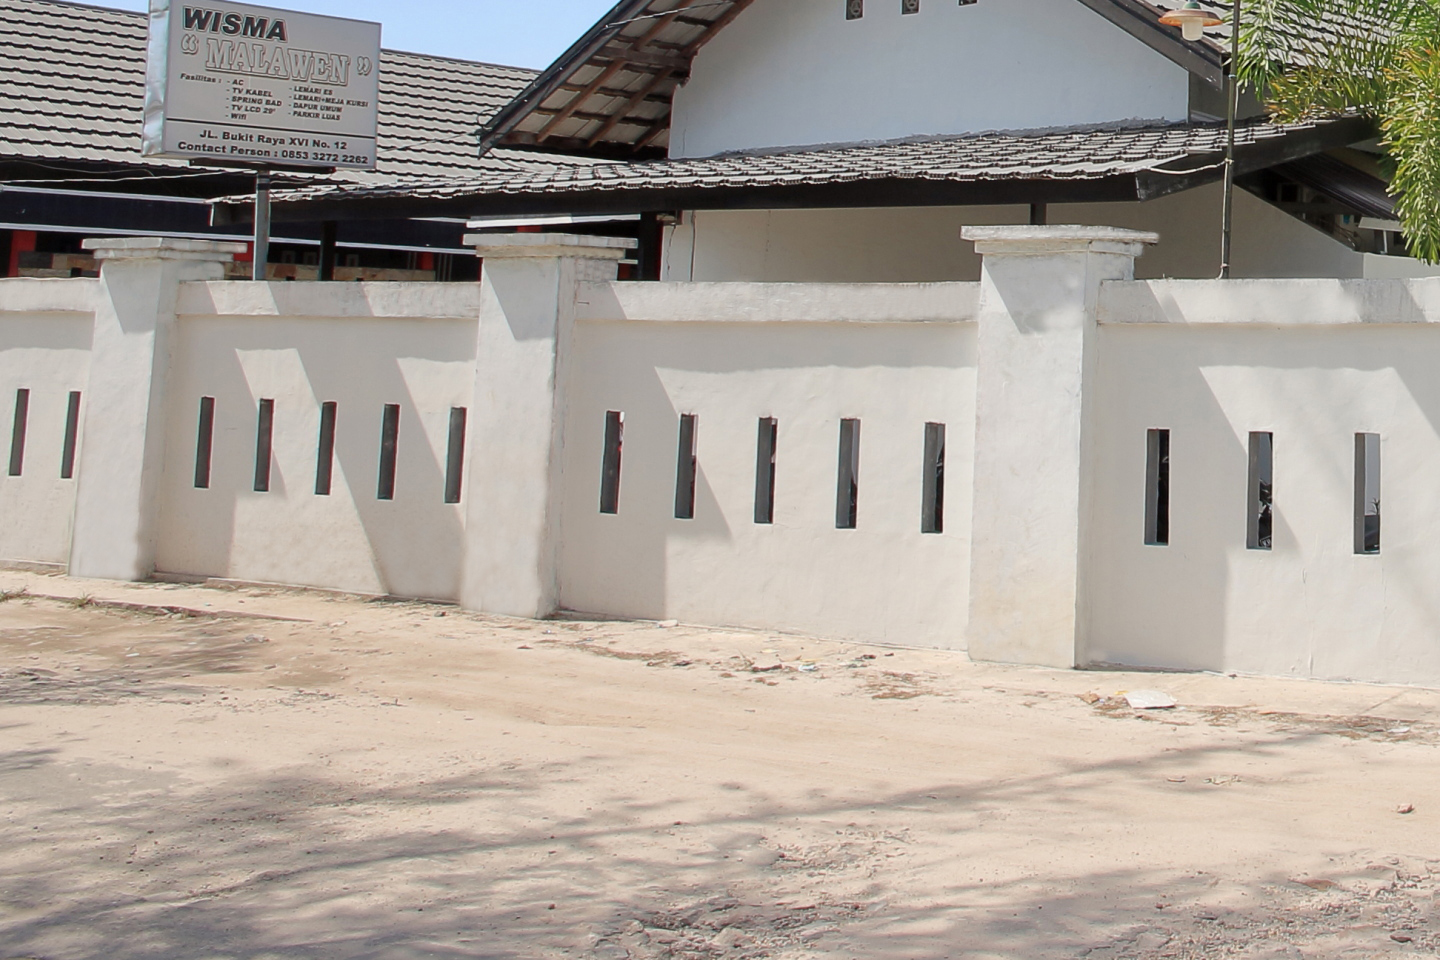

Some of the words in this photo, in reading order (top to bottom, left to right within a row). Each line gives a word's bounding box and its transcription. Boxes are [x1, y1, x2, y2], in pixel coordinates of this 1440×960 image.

[183, 6, 288, 43] WISMA
[205, 37, 350, 87] MALAWEN
[180, 73, 216, 83] Fasilitas
[232, 87, 243, 95] TV
[245, 88, 273, 98] KABEL
[294, 86, 322, 94] LEMARI
[231, 96, 263, 105] SPRING
[265, 99, 283, 107] BAD
[346, 100, 369, 108] KURSI
[231, 104, 243, 112] TV
[244, 106, 261, 114] LCD
[292, 102, 318, 111] DAPUR
[320, 105, 343, 113] UMUM
[292, 111, 320, 119] PARKIR
[321, 113, 341, 121] LUAS
[200, 129, 219, 140] JL.
[222, 131, 254, 143] Bukit
[257, 135, 286, 146] Raya
[288, 137, 309, 147] XVI
[312, 140, 330, 149] No.
[334, 141, 347, 150] 12
[178, 141, 227, 154] Contact
[230, 145, 271, 157] Person
[281, 149, 309, 160] 0853
[312, 152, 339, 163] 3272
[342, 154, 369, 165] 2262
